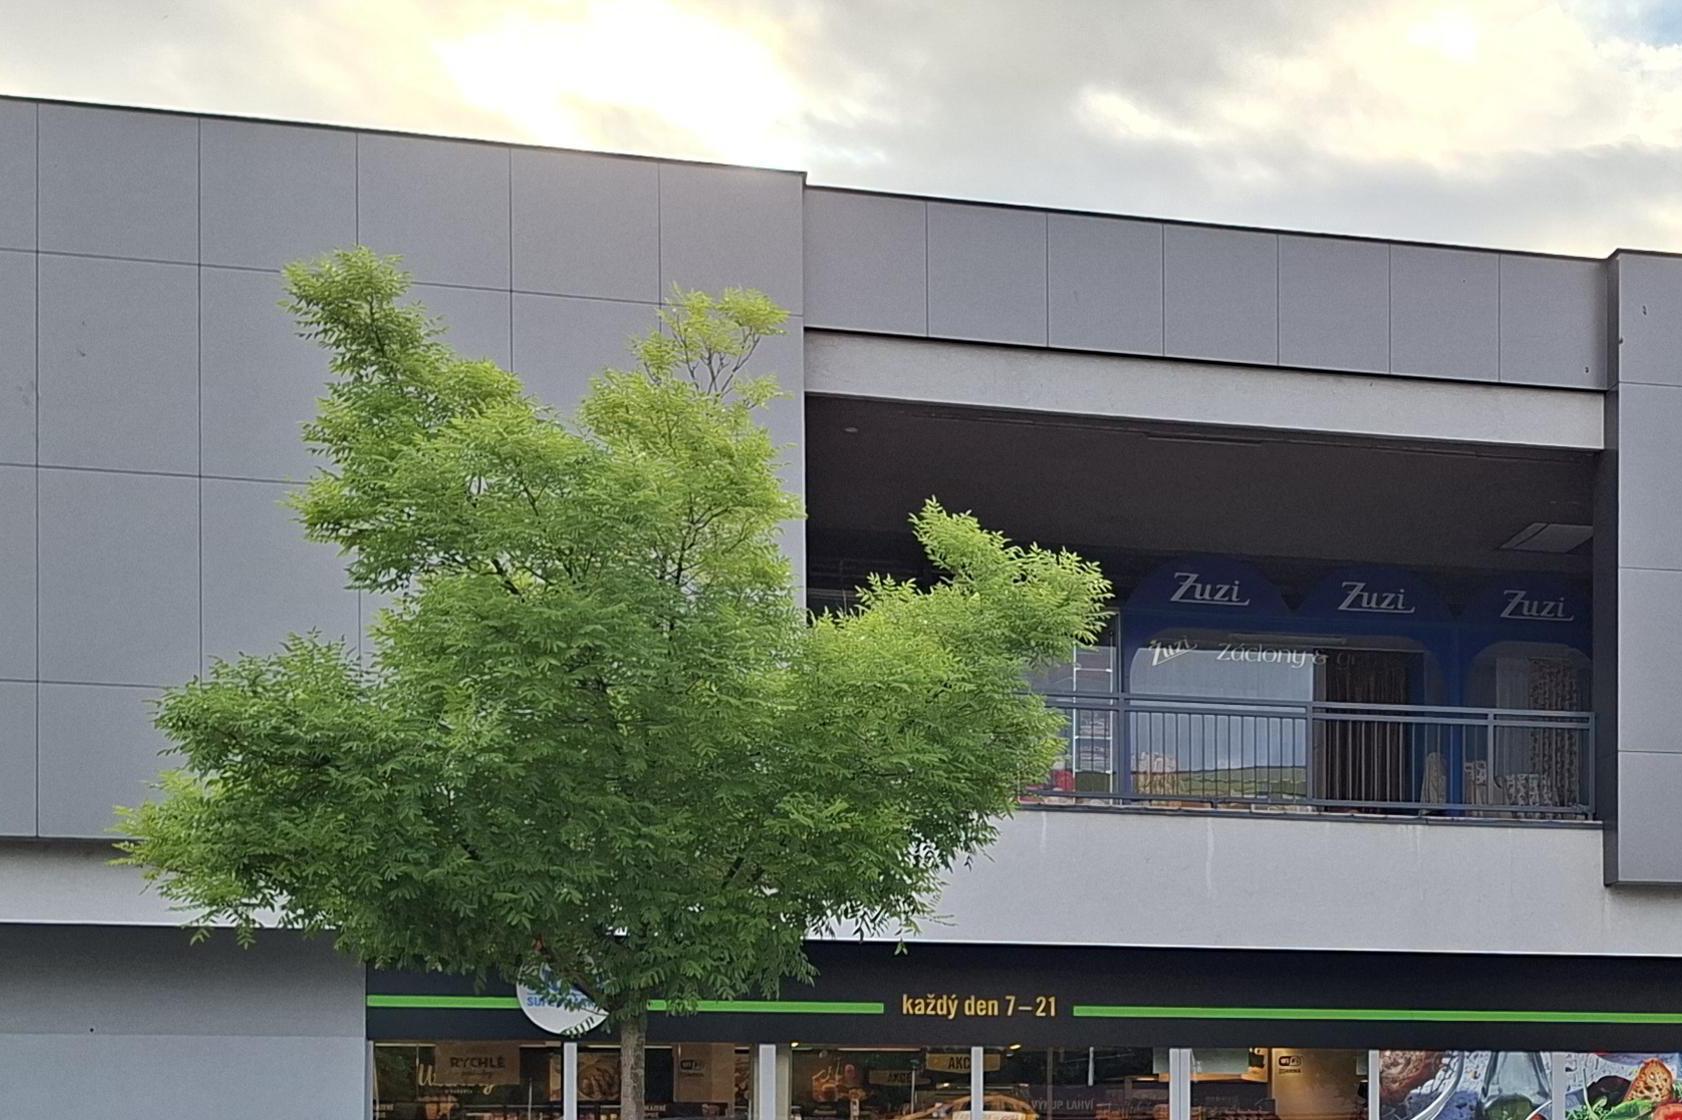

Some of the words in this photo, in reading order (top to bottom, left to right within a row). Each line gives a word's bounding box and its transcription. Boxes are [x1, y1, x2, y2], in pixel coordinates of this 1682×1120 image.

[1170, 571, 1250, 606] Zuzi
[1338, 581, 1416, 614] Zuzi
[1501, 589, 1575, 621] Zuzi
[1149, 636, 1198, 666] Zuzi
[1216, 643, 1307, 668] Záclony
[902, 994, 958, 1020] každý
[964, 994, 999, 1016] den
[948, 1056, 971, 1070] AKC
